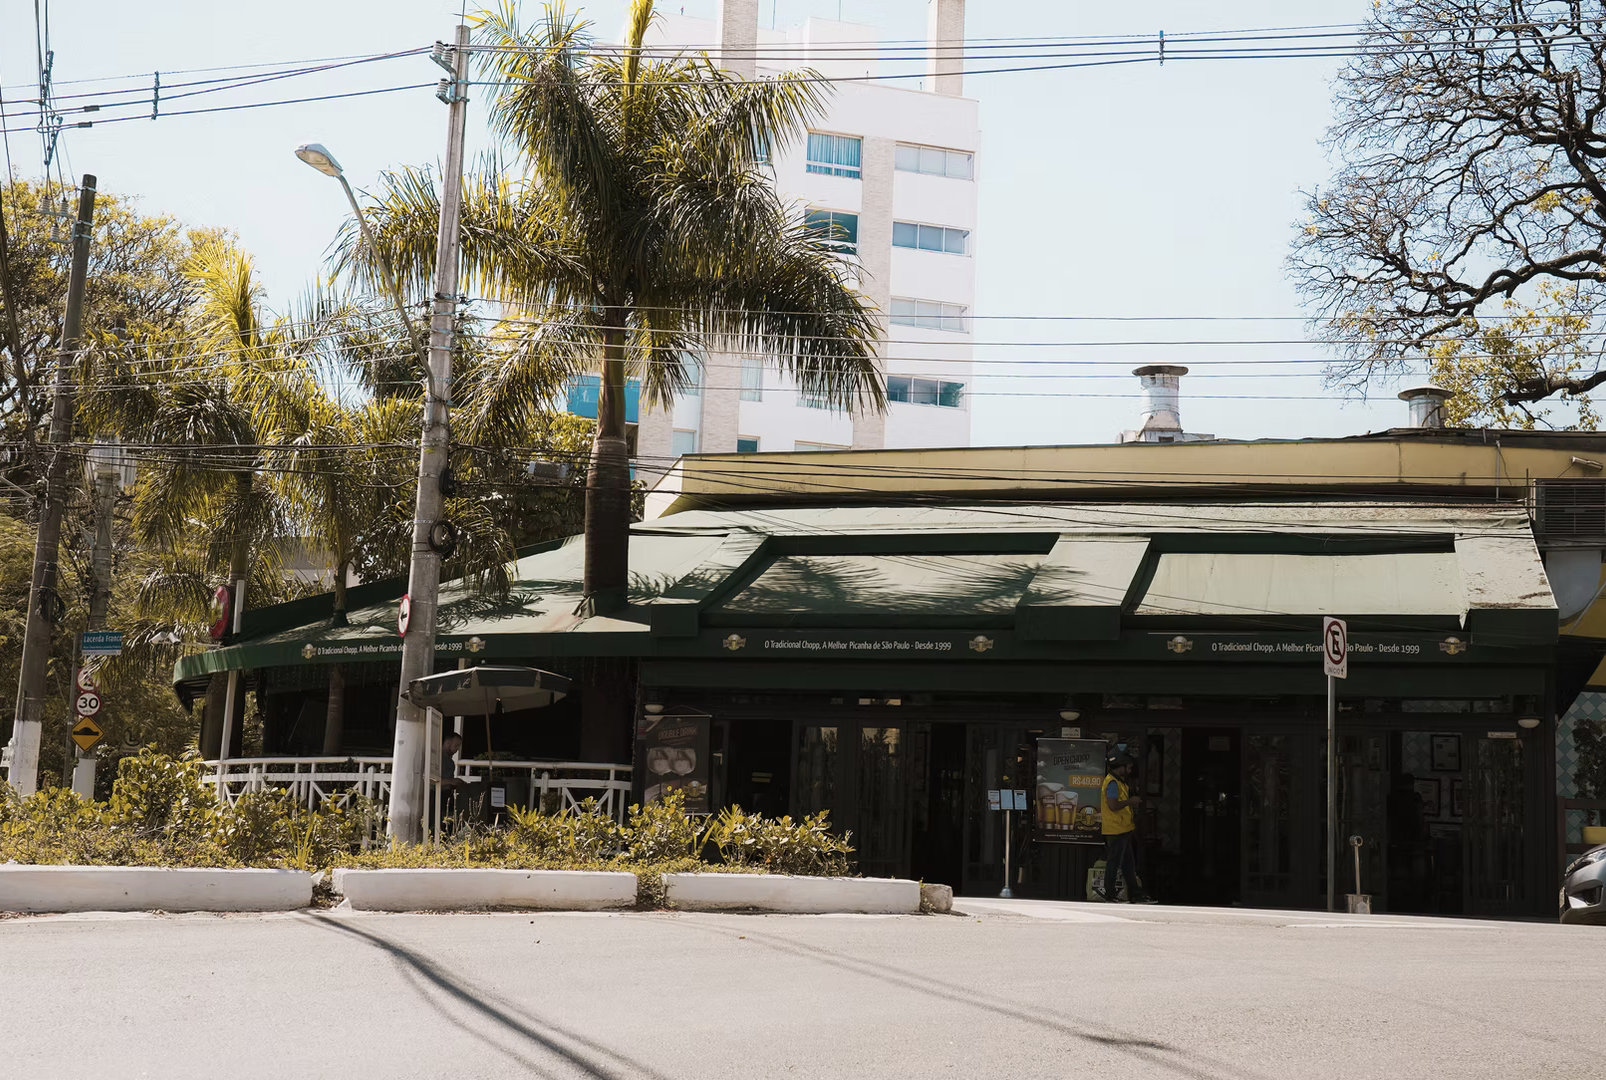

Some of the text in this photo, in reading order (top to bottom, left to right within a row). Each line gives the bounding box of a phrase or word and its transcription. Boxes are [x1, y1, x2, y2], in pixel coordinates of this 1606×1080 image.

[83, 635, 122, 643] Lacerda Franco
[317, 647, 322, 655] O
[322, 646, 343, 655] Tradicional
[363, 644, 378, 653] Melhor
[379, 644, 397, 652] Picanha
[434, 642, 448, 650] esde
[448, 642, 462, 651] 1999
[764, 640, 770, 649] O
[770, 640, 801, 649] Tradicional
[802, 640, 822, 651] Chopp,
[822, 641, 827, 649] A
[828, 640, 848, 650] Melhor
[849, 640, 872, 650] Picanha
[872, 640, 881, 650] de
[882, 640, 892, 650] São
[893, 640, 910, 650] Paulo
[914, 641, 934, 650] Desde
[934, 641, 952, 651] 1999
[1211, 642, 1217, 652] O
[1218, 642, 1252, 652] Tradicional
[1253, 642, 1275, 653] Chopp,
[1276, 643, 1281, 652] A
[1282, 643, 1304, 652] Melhor
[1355, 644, 1373, 652] Paulo
[1379, 644, 1400, 653] Desde
[1400, 644, 1420, 654] 1999
[78, 697, 98, 709] 30
[1053, 753, 1090, 766] OPEN CHOPP
